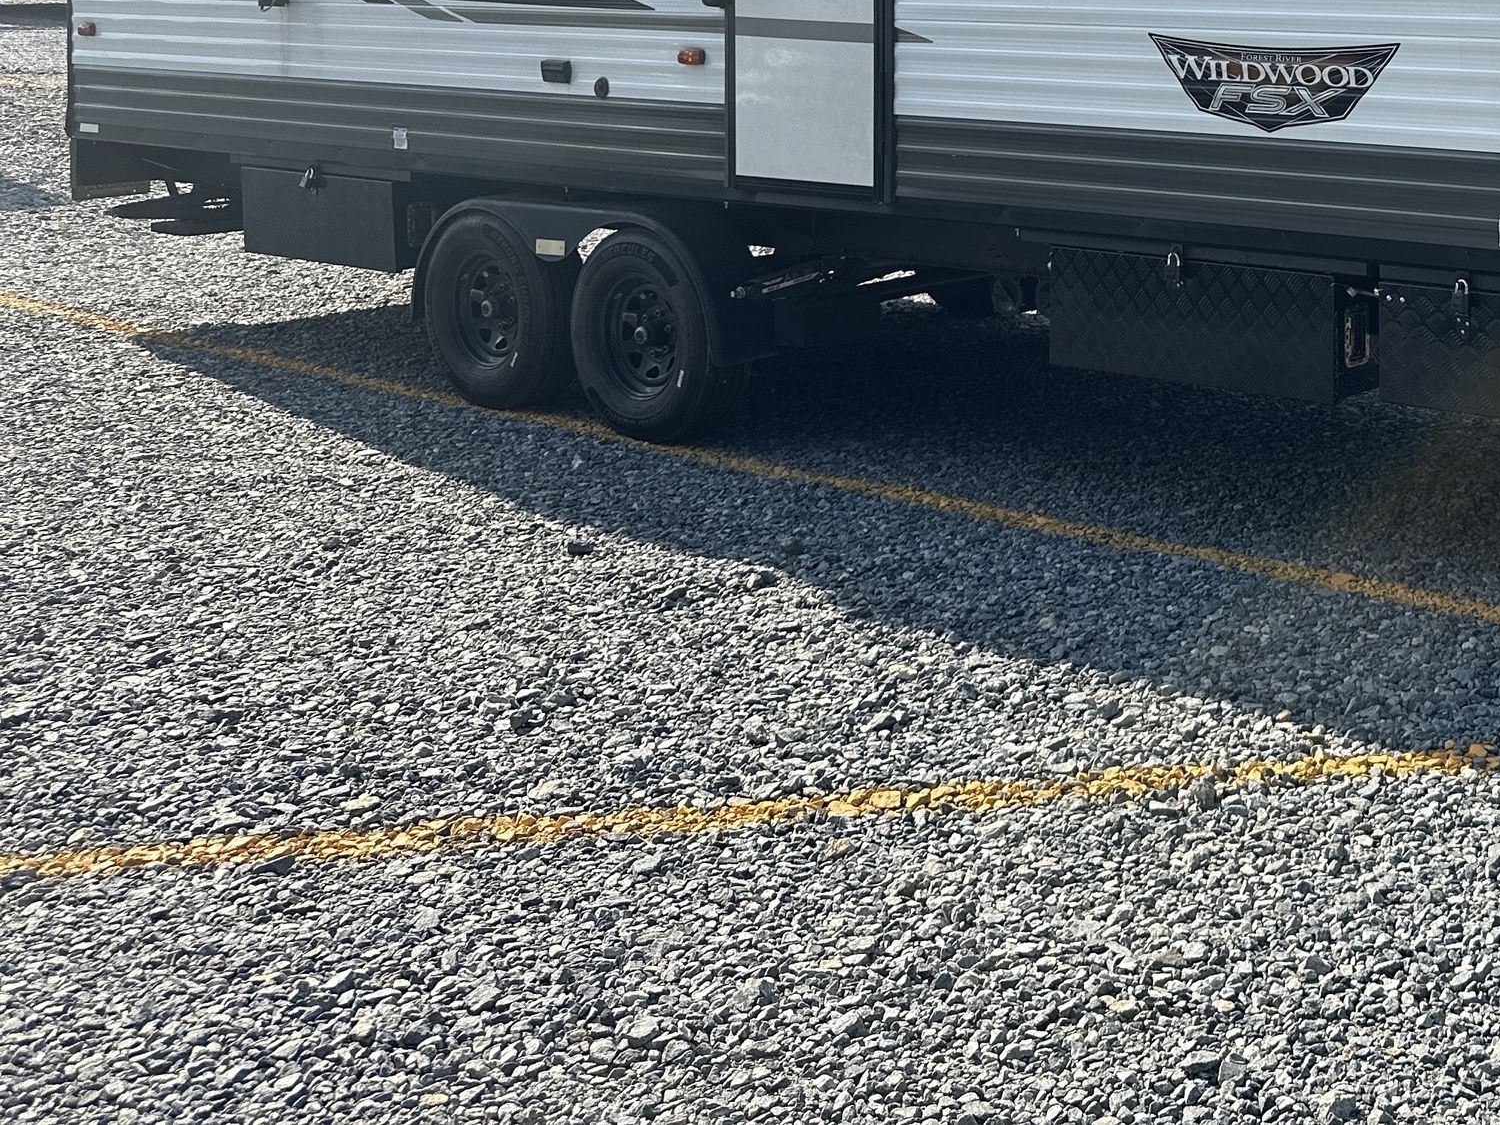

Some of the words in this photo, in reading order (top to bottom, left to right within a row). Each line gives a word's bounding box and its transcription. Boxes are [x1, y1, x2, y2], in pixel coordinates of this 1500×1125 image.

[1167, 54, 1376, 88] WILDWOOD
[1241, 52, 1274, 62] FOREST
[1275, 53, 1302, 64] RIVER
[1208, 83, 1347, 118] FSX
[600, 242, 655, 263] HERCULES
